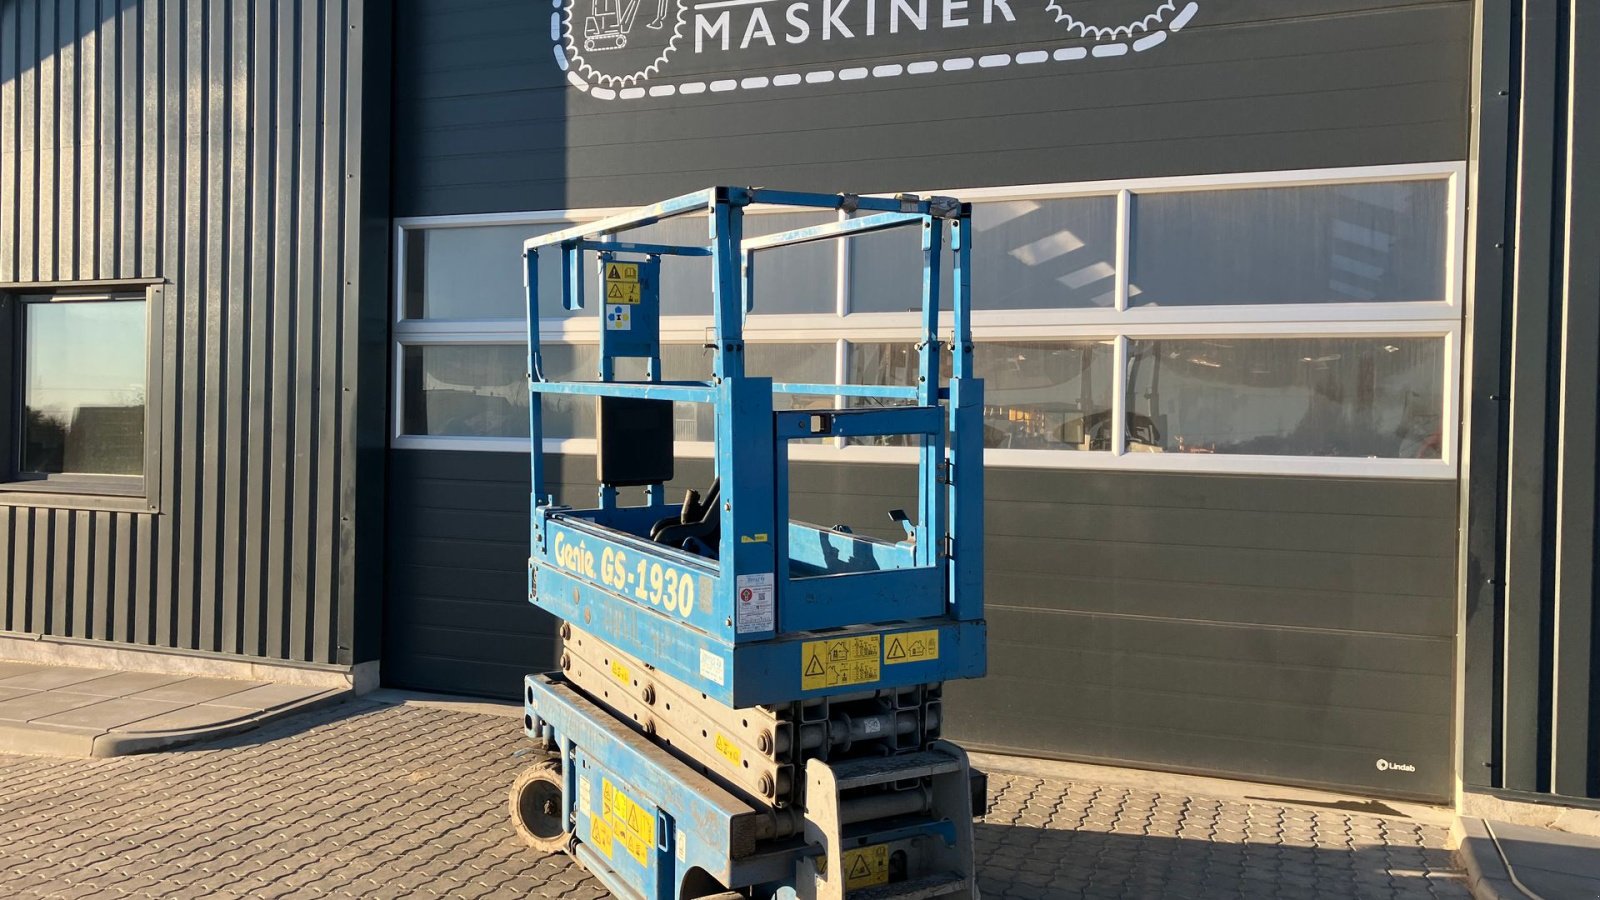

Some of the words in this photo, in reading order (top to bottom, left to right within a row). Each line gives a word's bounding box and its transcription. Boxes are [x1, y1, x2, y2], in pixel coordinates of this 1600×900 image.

[554, 531, 596, 579] Genie
[601, 546, 694, 618] GS-1930
[1388, 762, 1416, 772] Lindab
